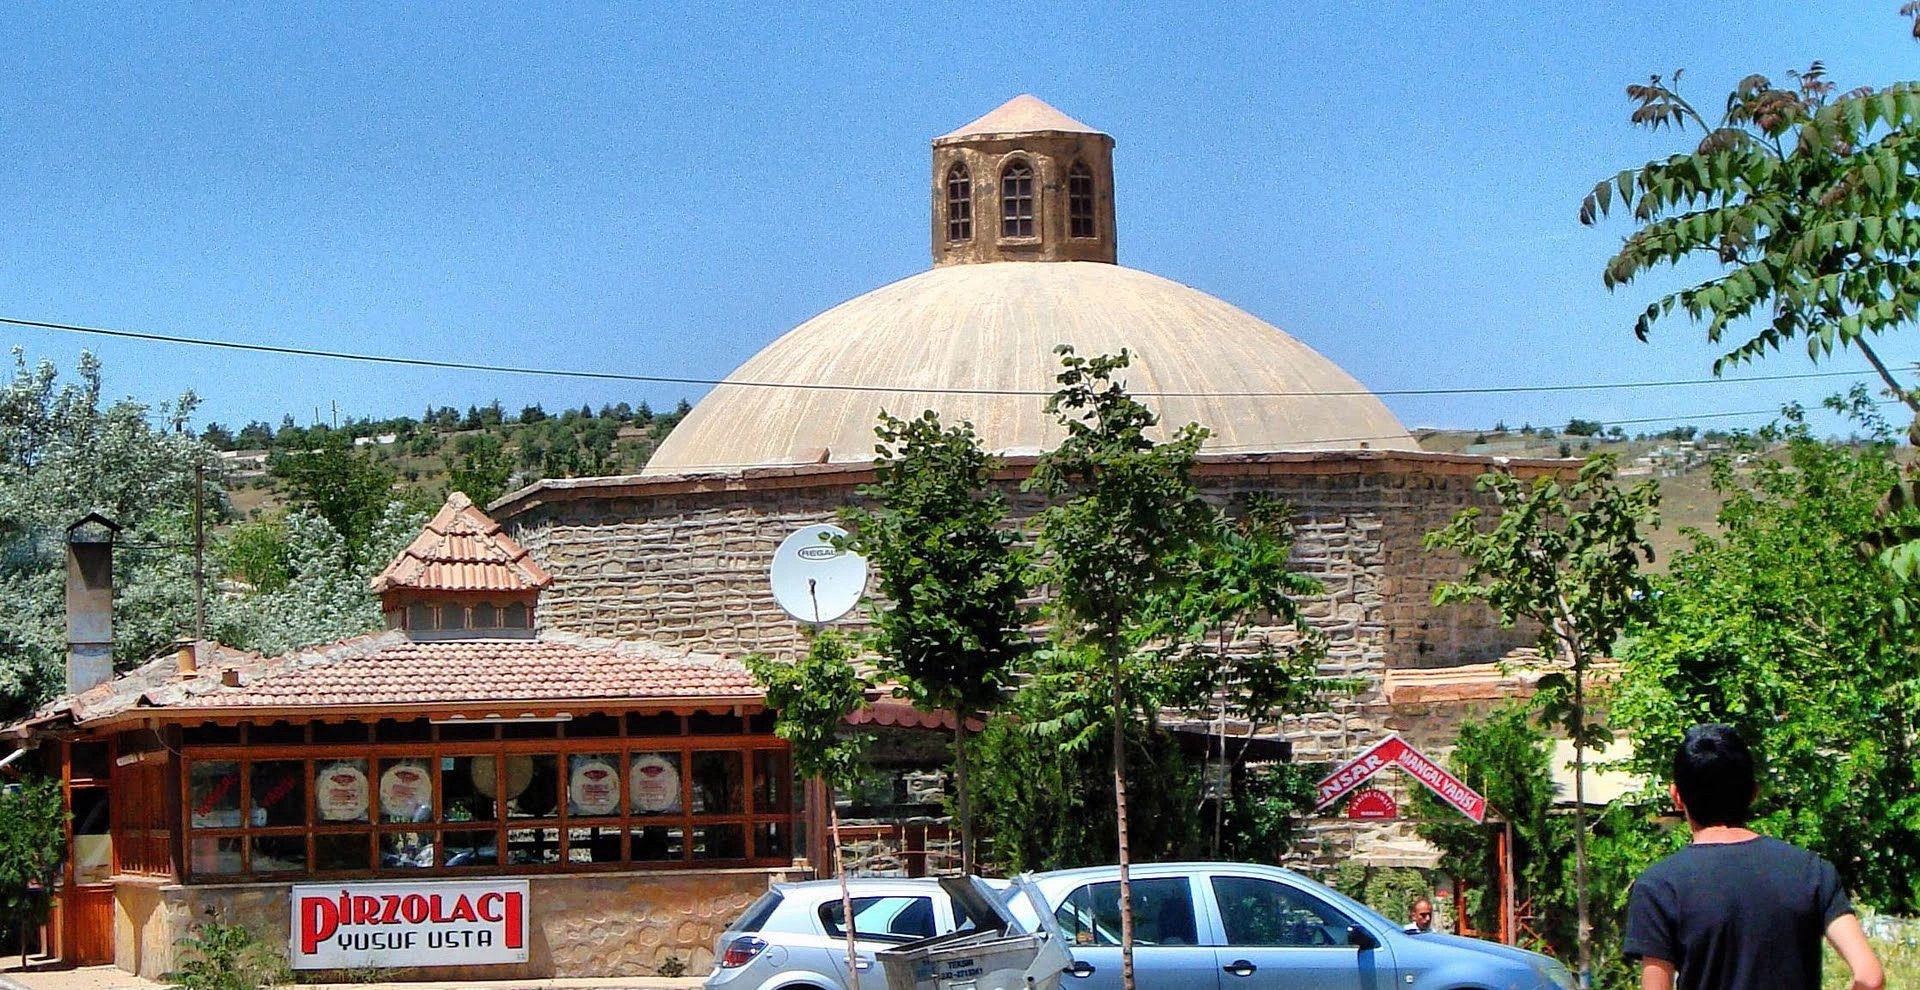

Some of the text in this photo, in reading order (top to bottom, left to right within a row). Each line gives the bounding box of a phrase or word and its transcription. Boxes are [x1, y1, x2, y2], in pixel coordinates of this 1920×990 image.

[801, 549, 835, 557] REGAL
[1399, 749, 1443, 787] MANGAL
[301, 890, 523, 954] PİRZOLACI
[338, 930, 492, 950] YUSUF USTA
